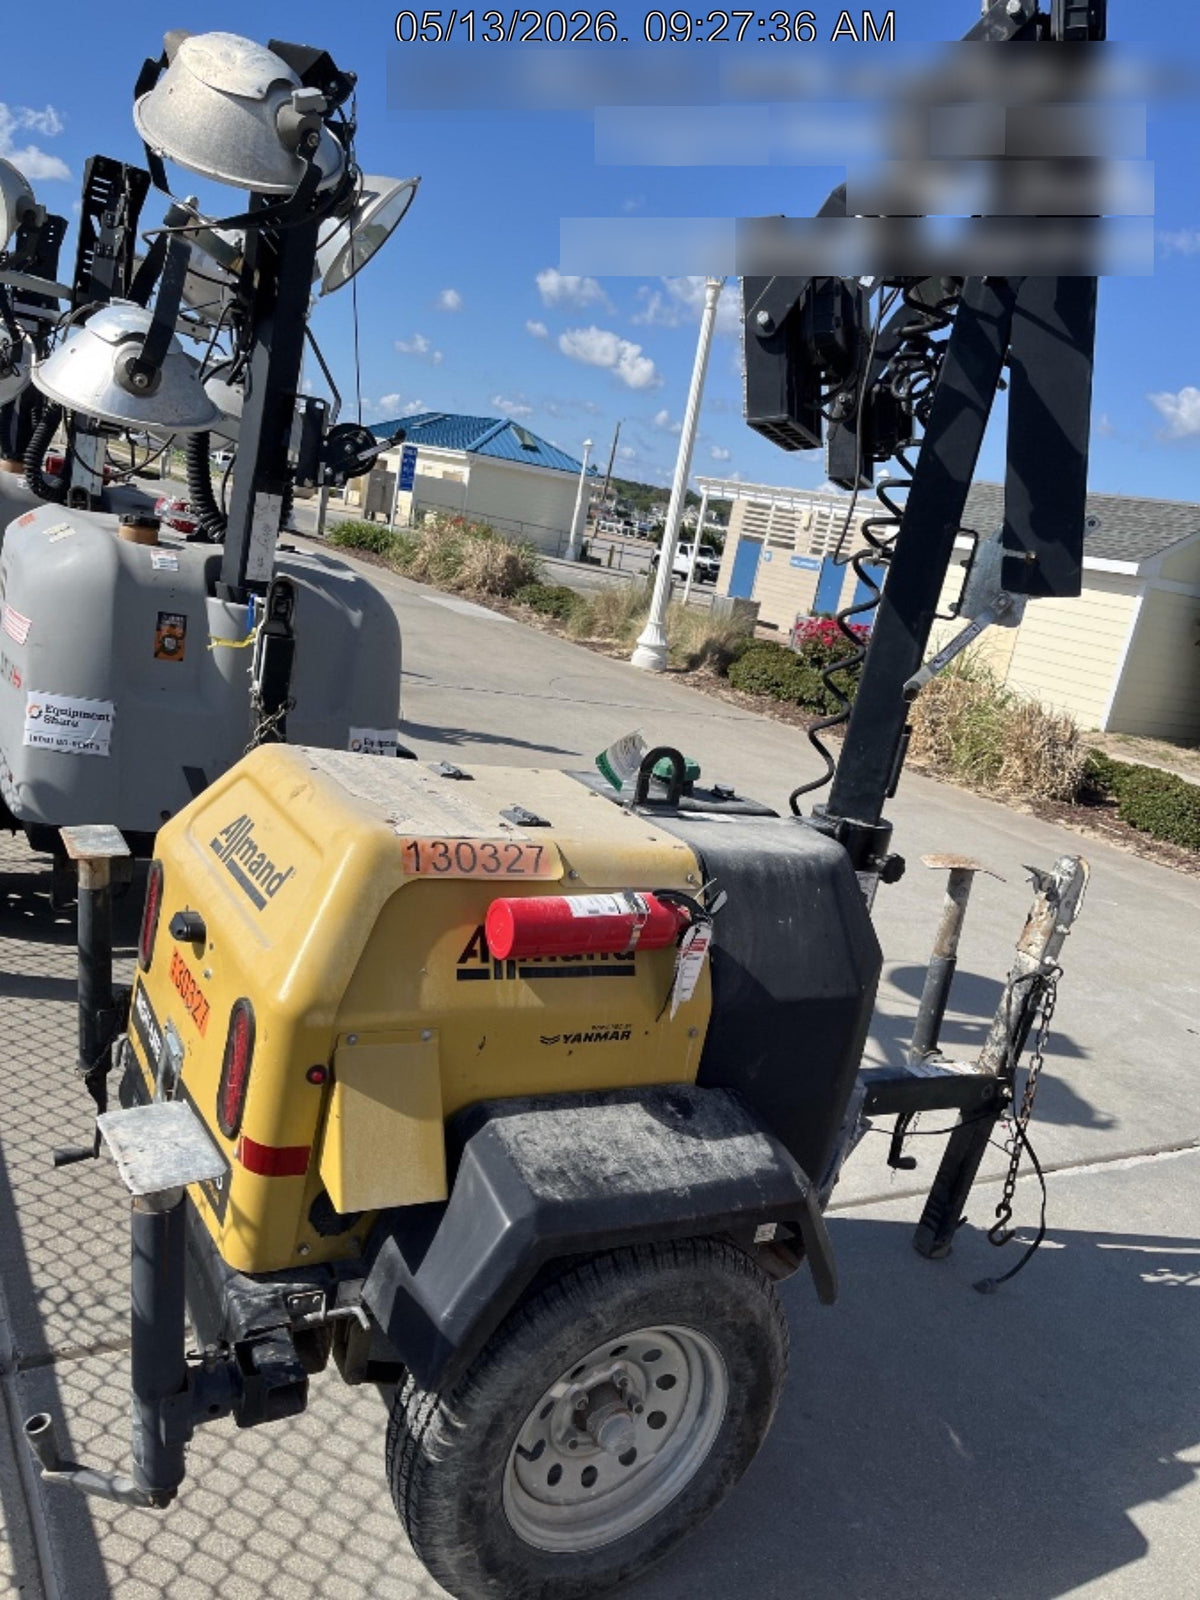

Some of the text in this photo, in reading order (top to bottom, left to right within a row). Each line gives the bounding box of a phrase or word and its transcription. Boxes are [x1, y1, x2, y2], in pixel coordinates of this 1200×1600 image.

[45, 704, 110, 722] Equipment
[219, 814, 293, 898] Allmand
[406, 840, 544, 873] 130327
[563, 1030, 632, 1044] YANMAR
